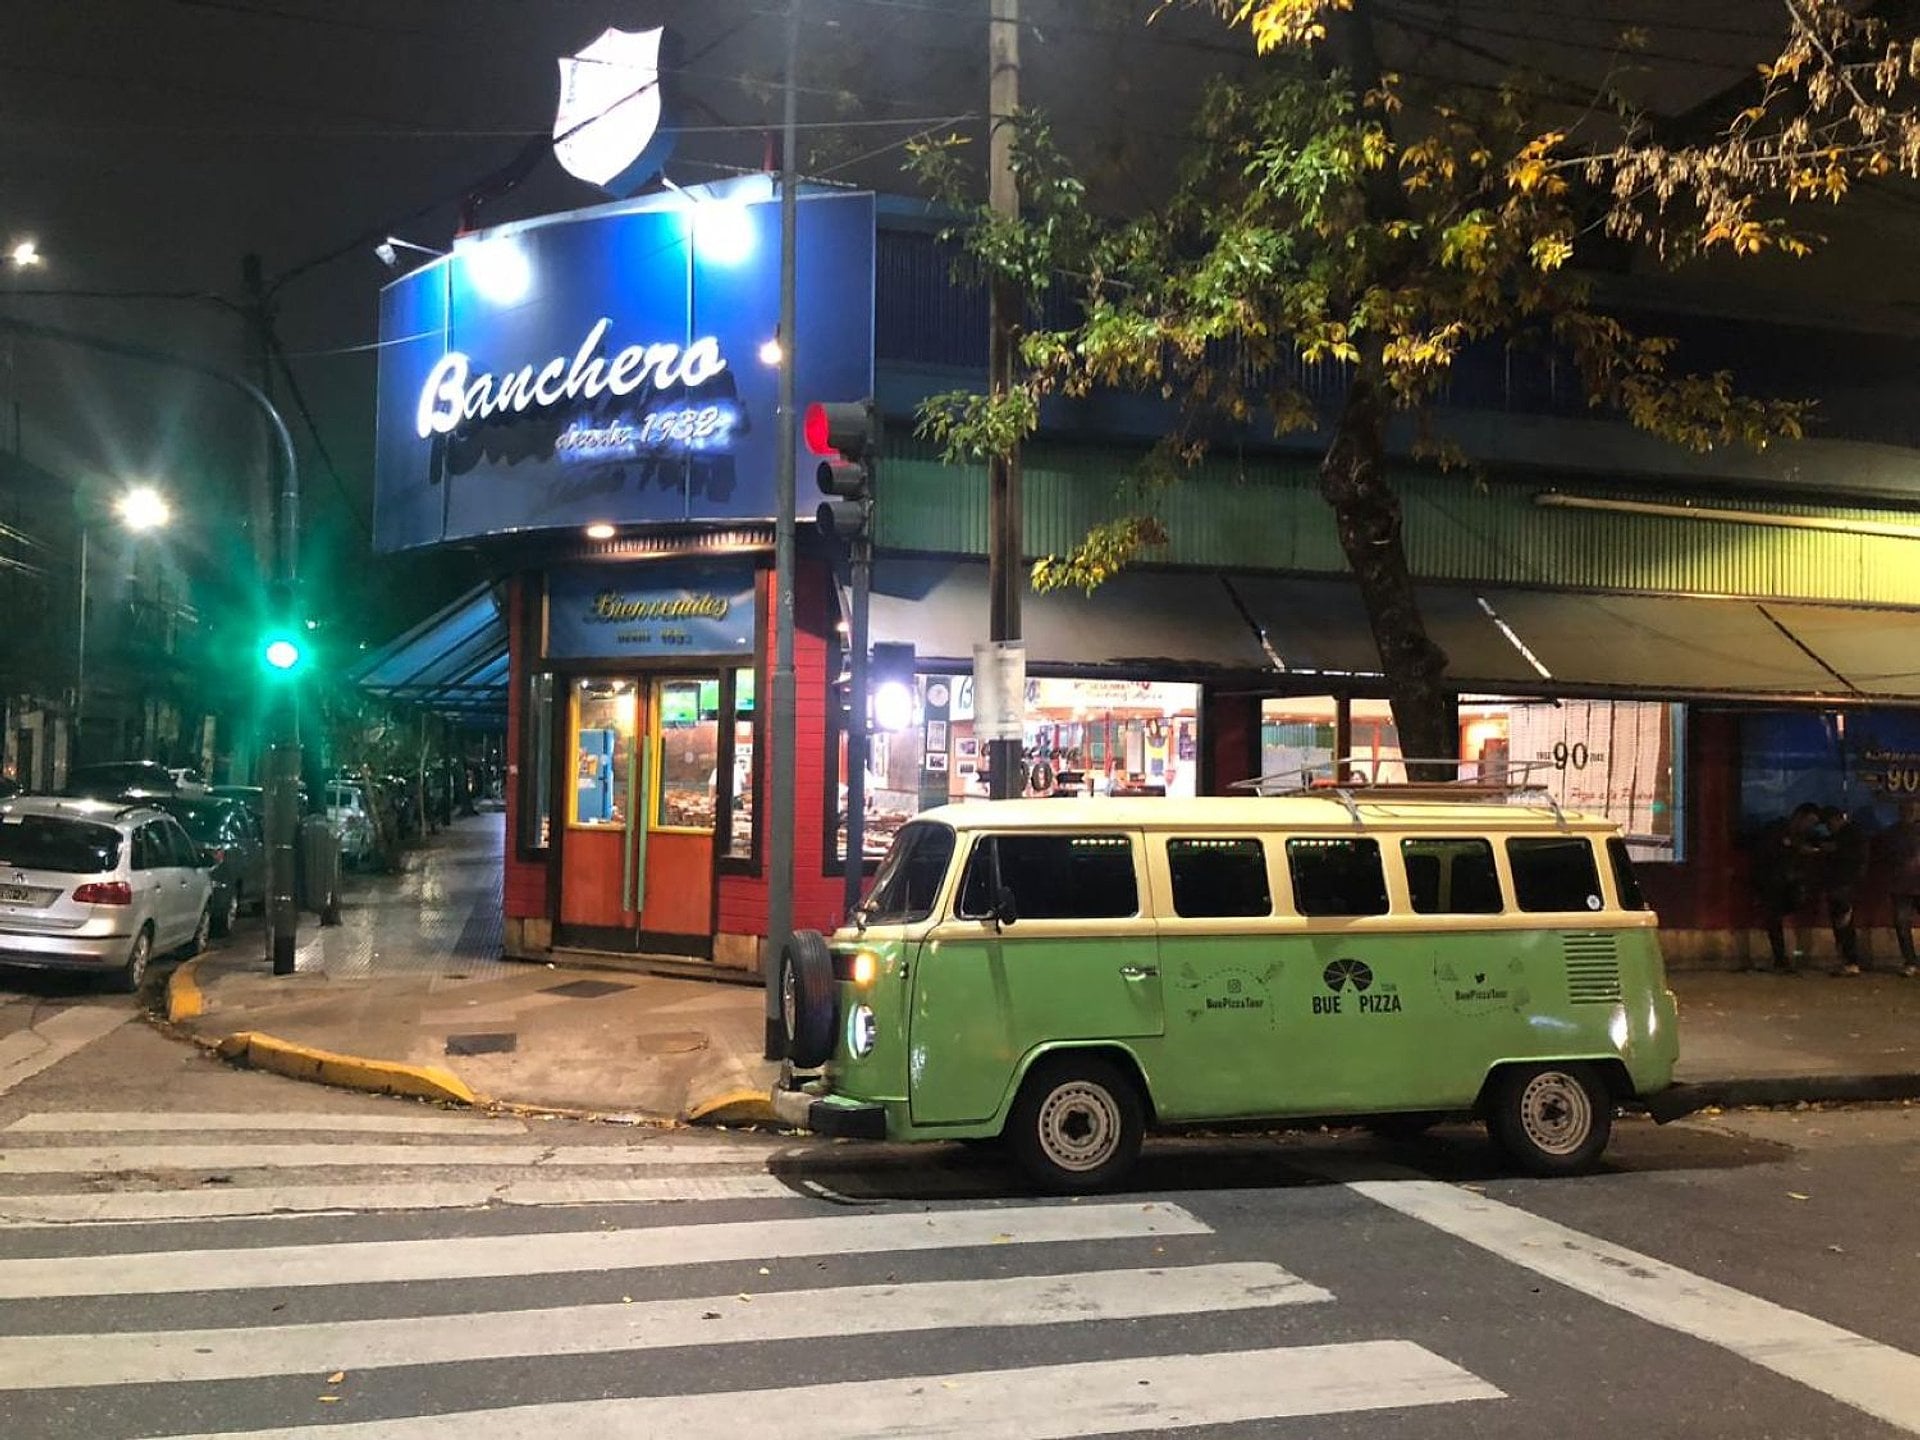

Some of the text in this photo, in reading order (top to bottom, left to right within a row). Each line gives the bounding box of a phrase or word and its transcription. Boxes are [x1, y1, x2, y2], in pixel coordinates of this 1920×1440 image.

[416, 317, 727, 439] Banchero
[554, 404, 720, 450] desde 1932
[1553, 742, 1589, 770] 90
[1312, 993, 1402, 1015] BUE PIZZA
